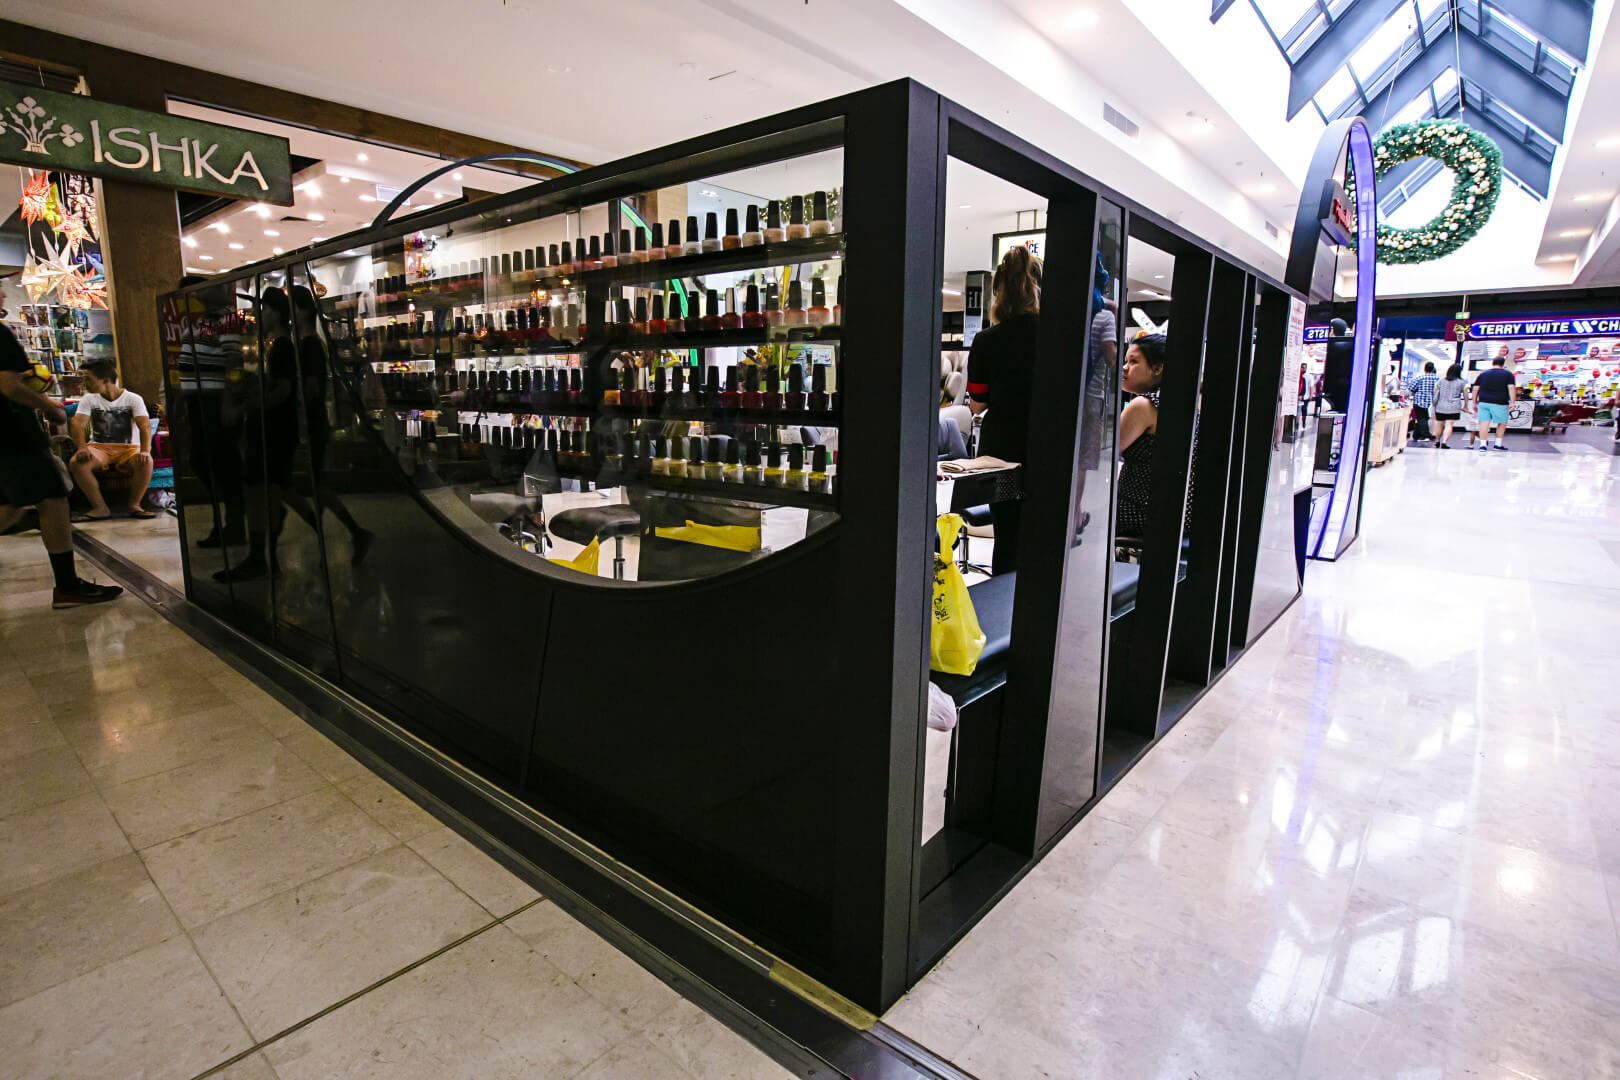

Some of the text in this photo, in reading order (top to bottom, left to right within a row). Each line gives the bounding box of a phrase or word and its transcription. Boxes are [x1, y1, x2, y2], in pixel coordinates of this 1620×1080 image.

[89, 119, 269, 191] ISHKA
[1479, 320, 1620, 335] TERRY WHITE CH
